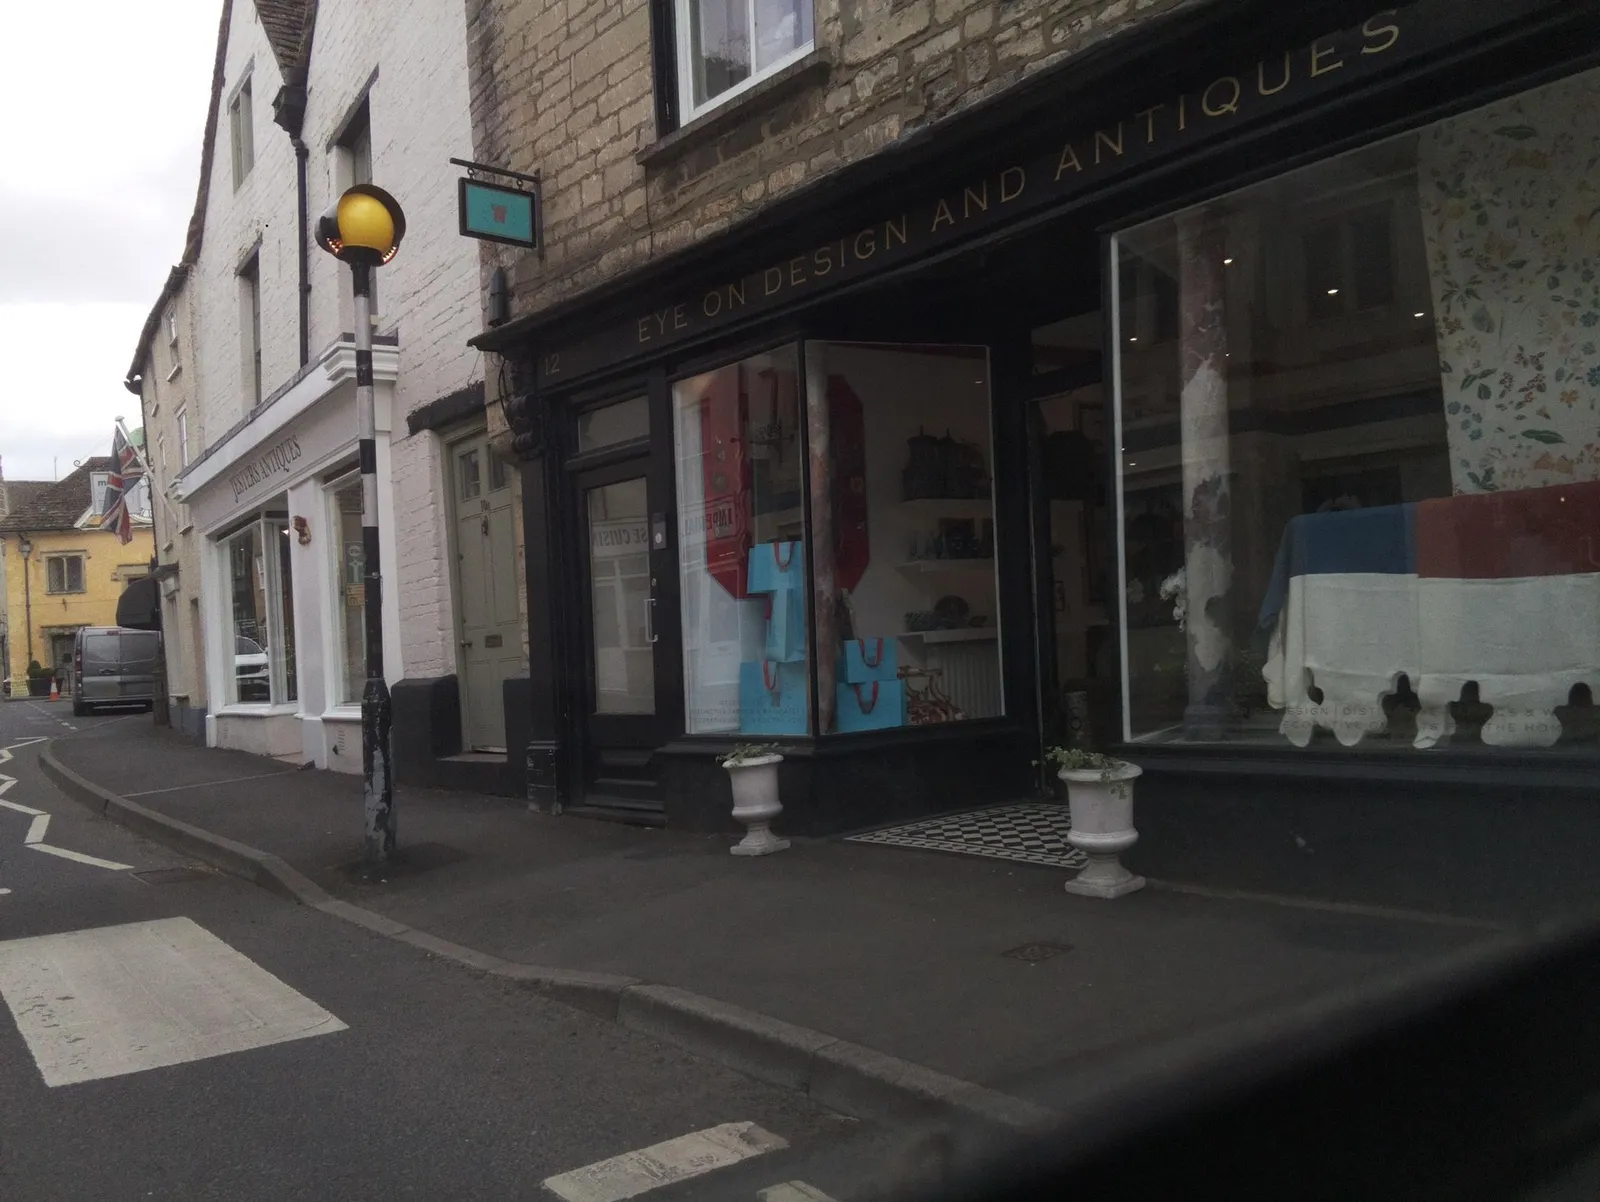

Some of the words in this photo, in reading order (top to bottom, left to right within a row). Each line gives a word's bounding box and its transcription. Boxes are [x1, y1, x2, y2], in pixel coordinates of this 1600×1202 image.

[637, 302, 688, 343] EYE
[702, 279, 745, 317] ON
[763, 214, 907, 297] DESIGN
[931, 166, 1027, 232] AND
[1053, 8, 1401, 181] ANTIQUES
[544, 353, 560, 376] 12
[228, 463, 261, 503] JESTERS
[260, 434, 302, 478] ANTIQUES
